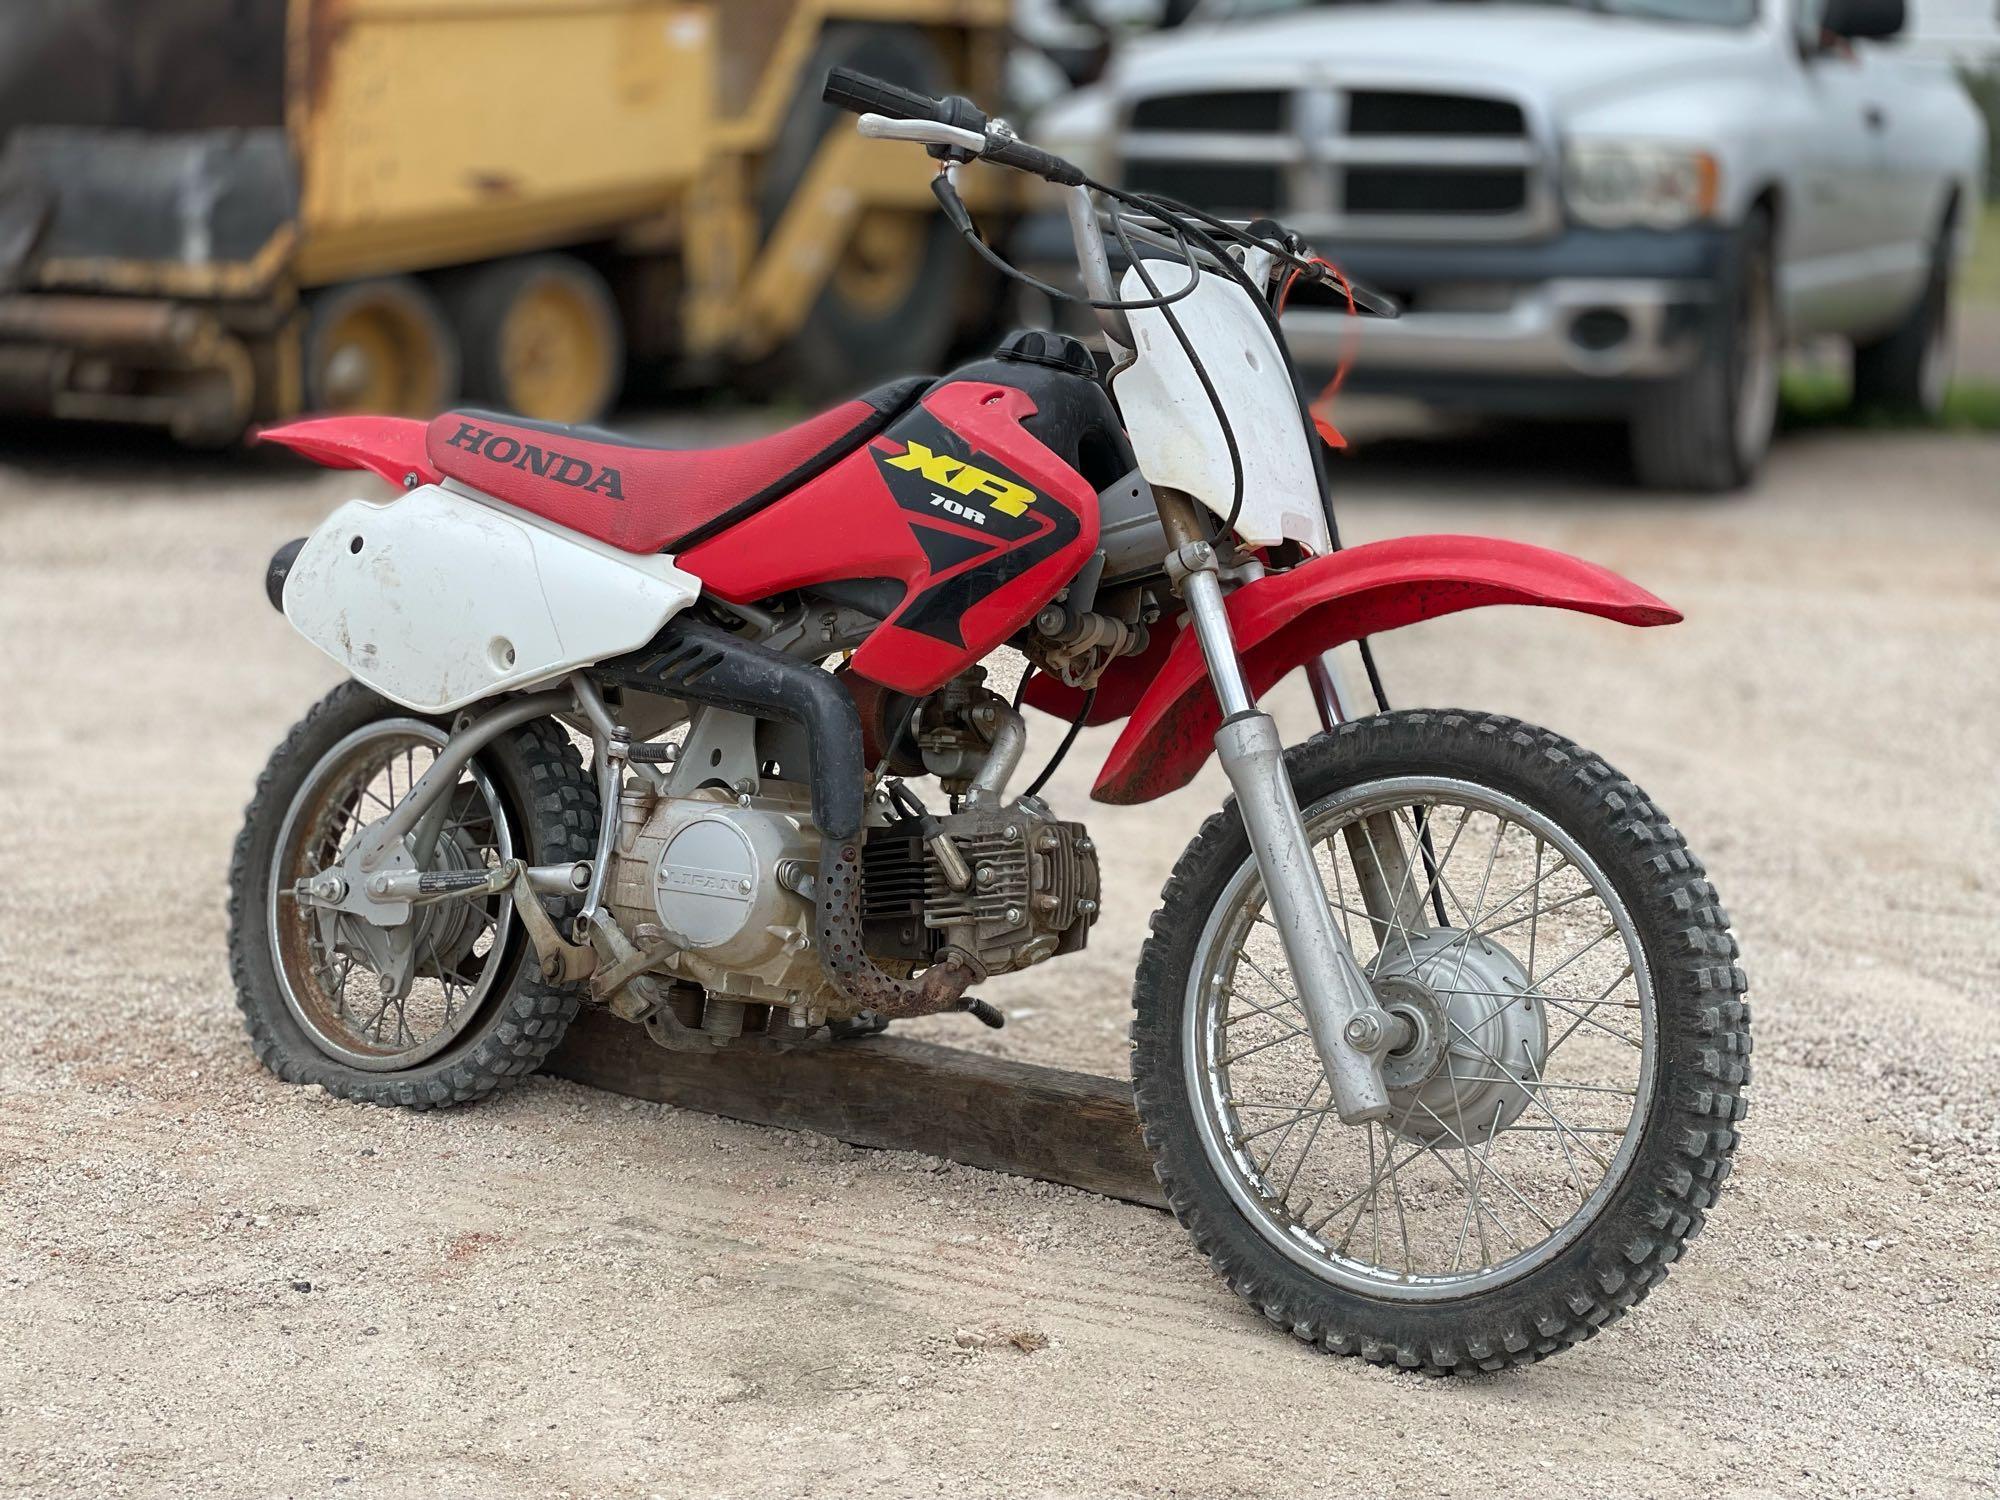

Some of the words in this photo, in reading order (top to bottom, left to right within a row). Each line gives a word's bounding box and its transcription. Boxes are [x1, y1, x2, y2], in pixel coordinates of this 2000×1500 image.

[446, 422, 625, 501] HONDA
[883, 439, 1038, 519] XR
[929, 492, 987, 526] 70R
[670, 871, 739, 892] LIFAN
